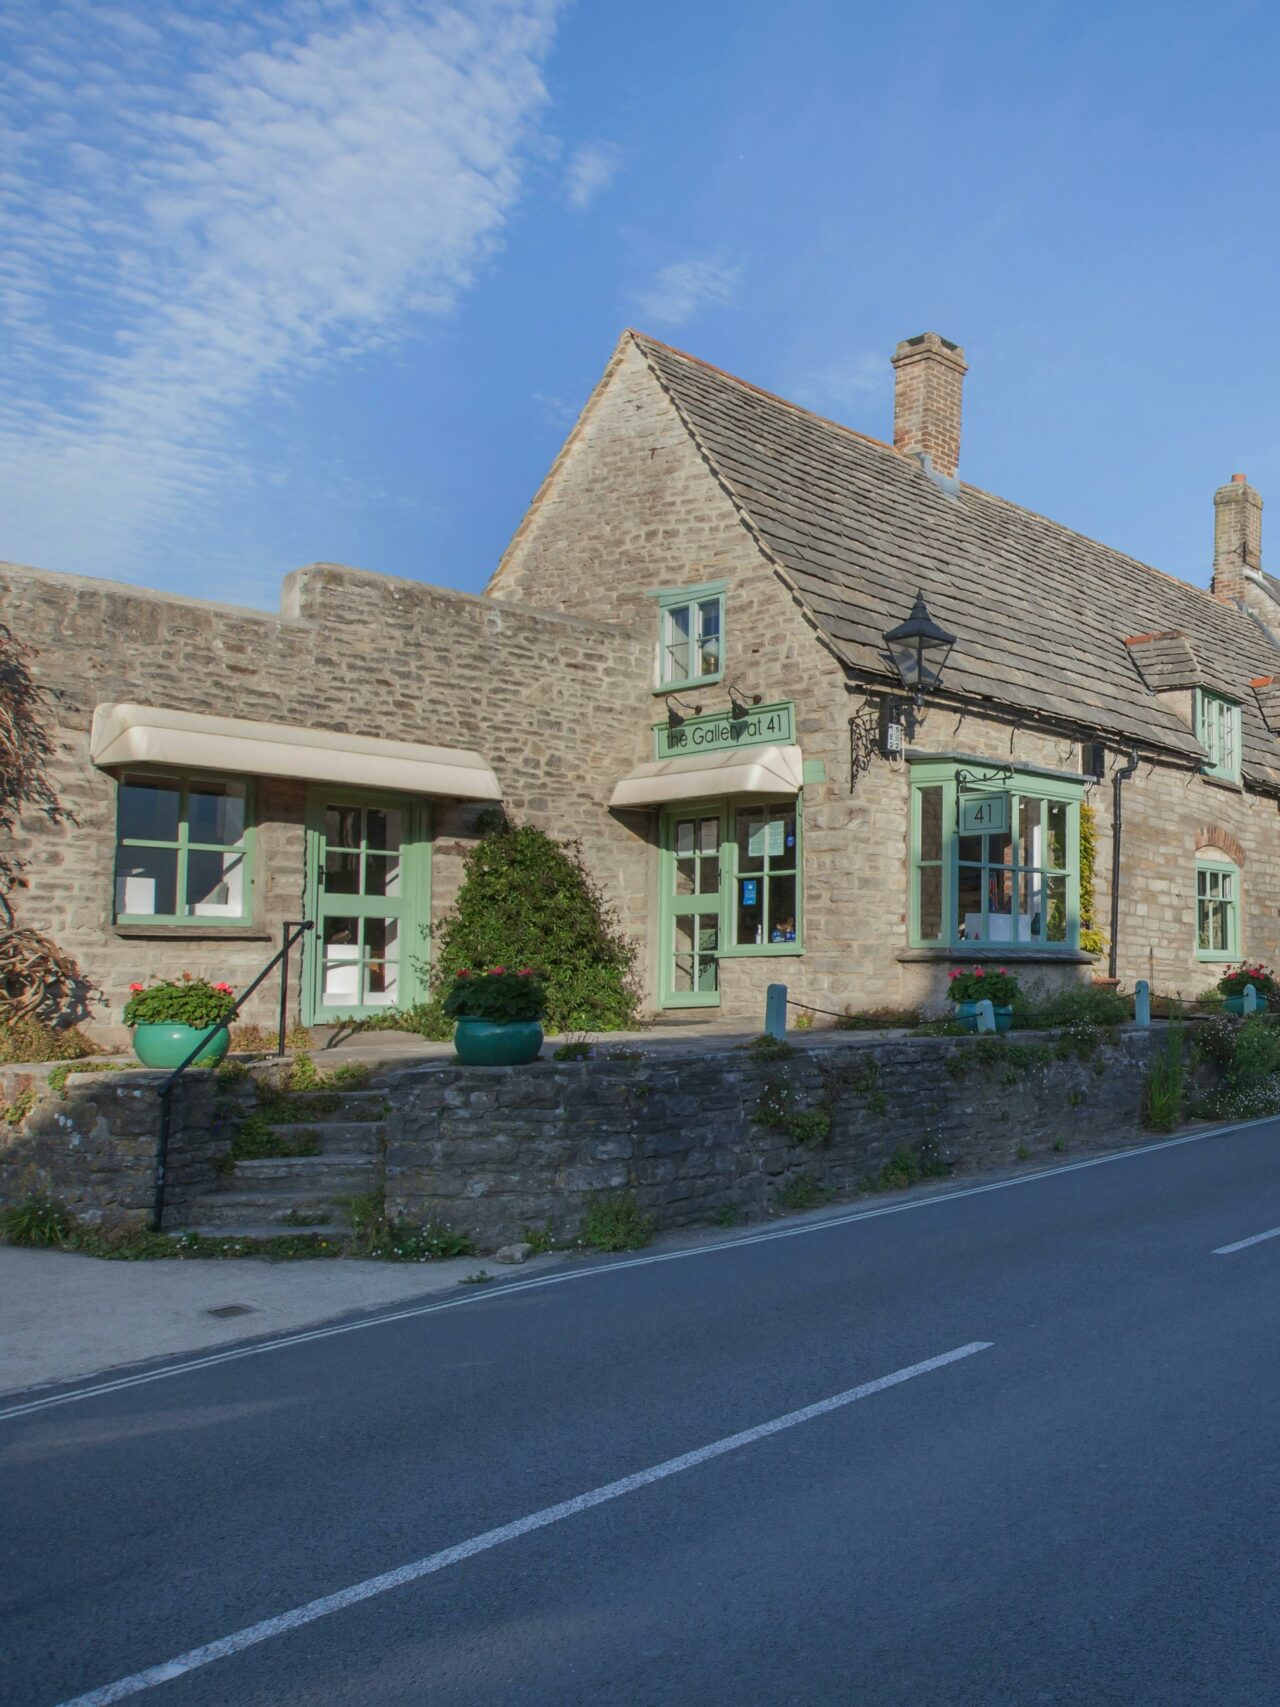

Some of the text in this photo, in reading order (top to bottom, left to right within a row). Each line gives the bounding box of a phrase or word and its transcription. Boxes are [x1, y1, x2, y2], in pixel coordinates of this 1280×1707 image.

[667, 714, 782, 750] the Gallery at 41
[974, 804, 991, 823] 41
